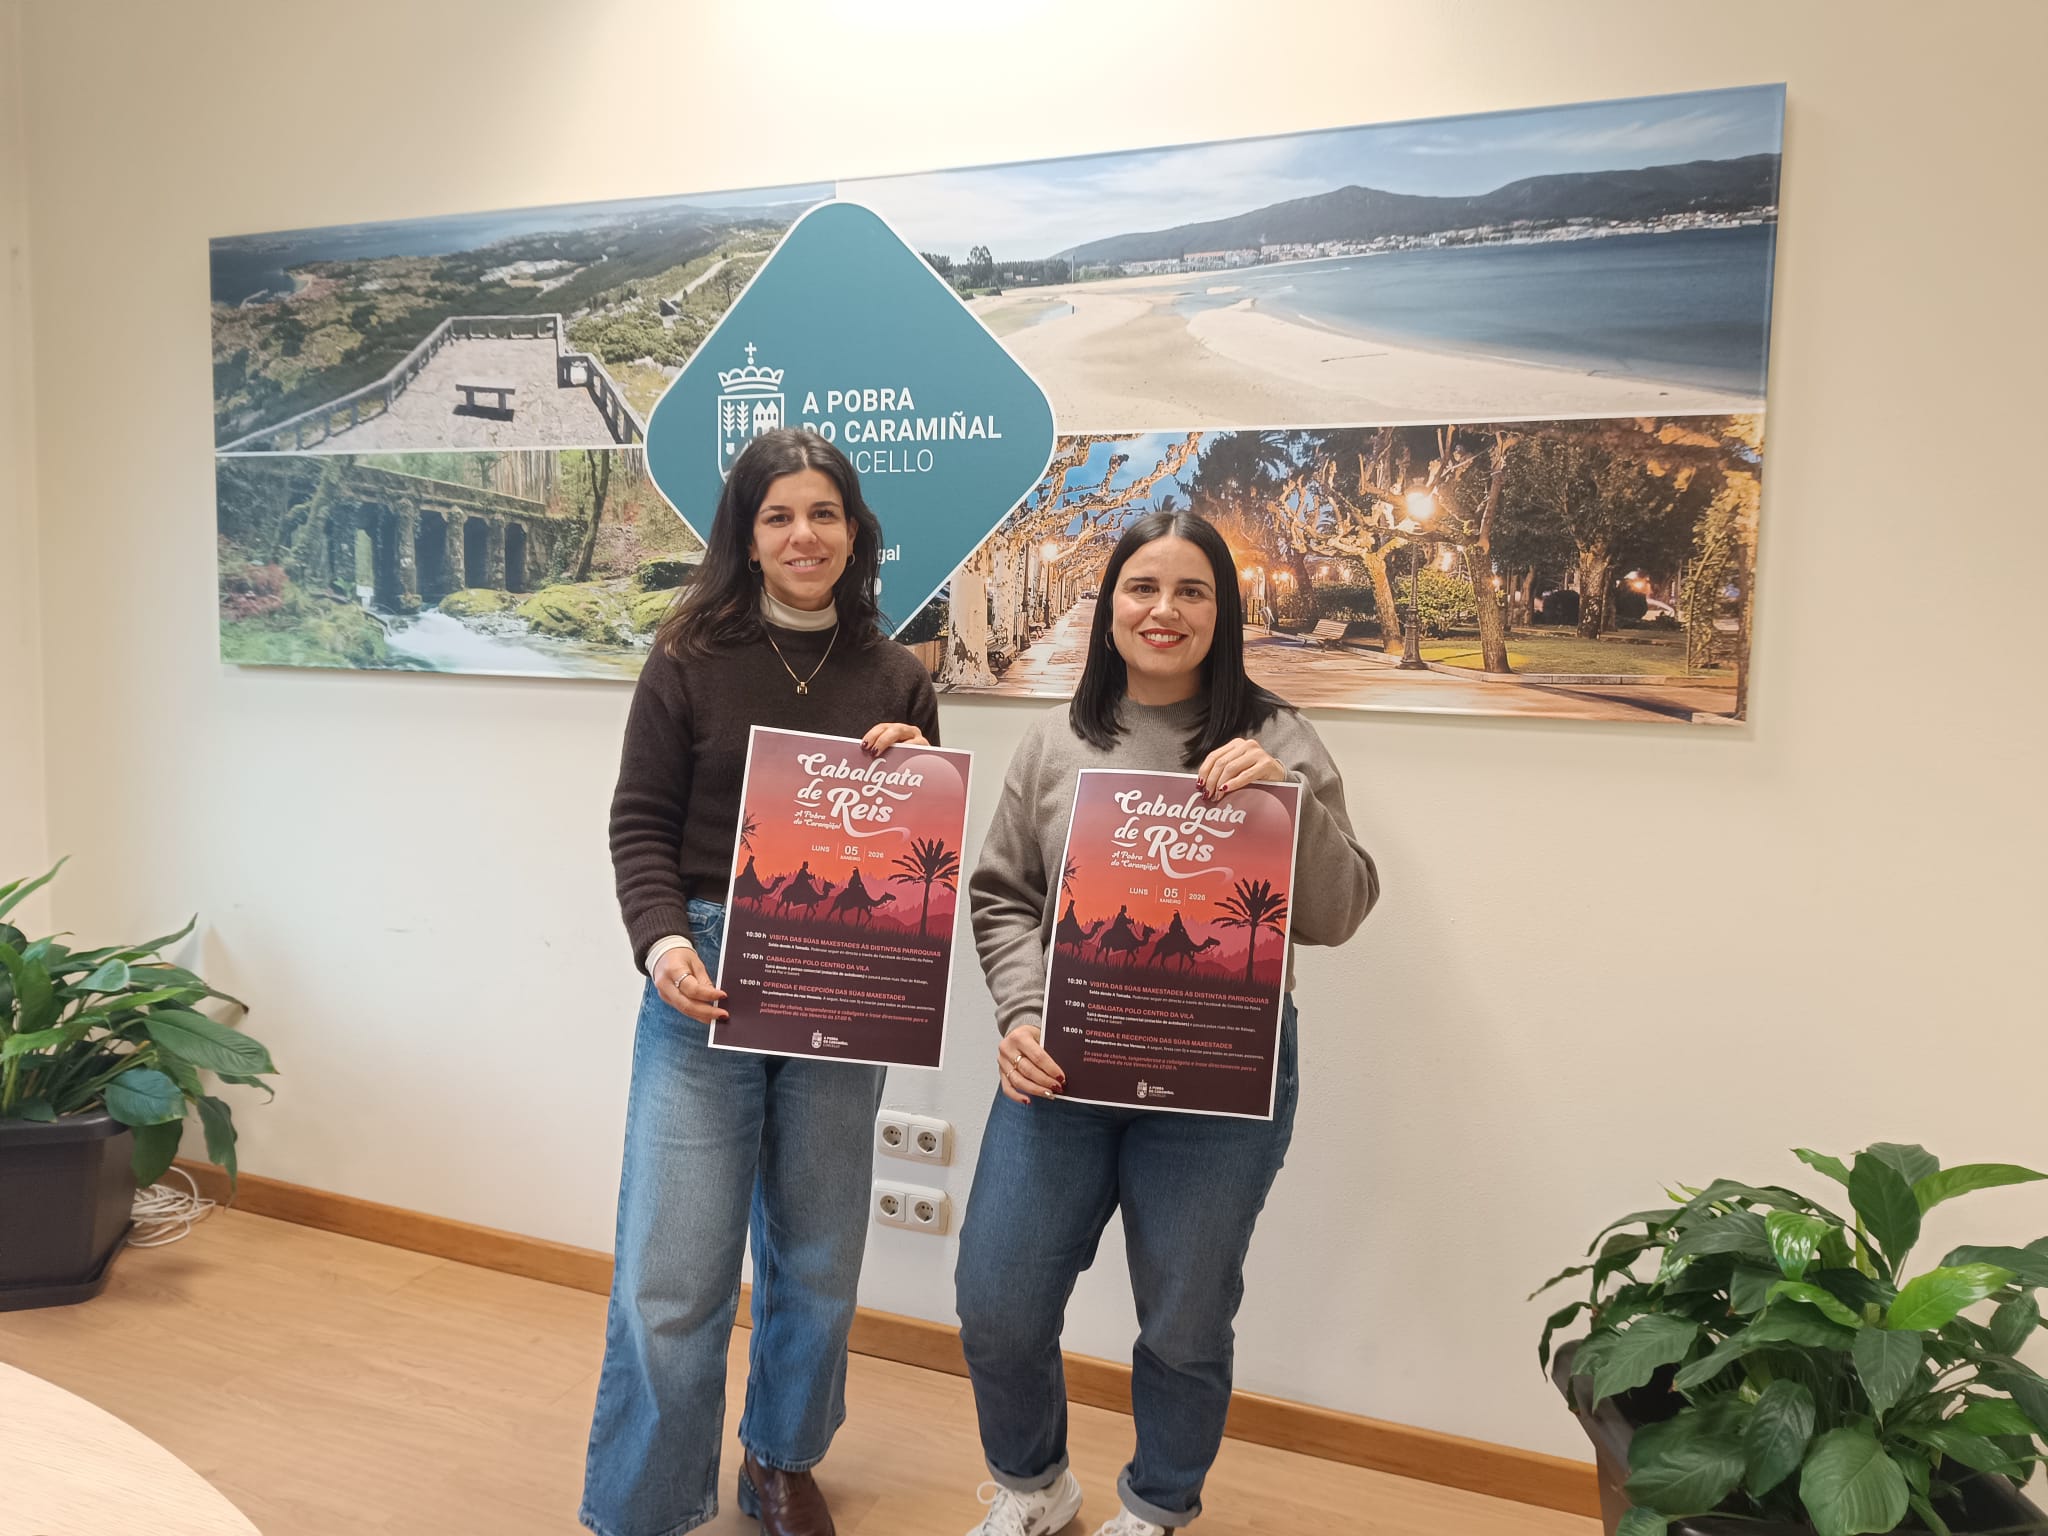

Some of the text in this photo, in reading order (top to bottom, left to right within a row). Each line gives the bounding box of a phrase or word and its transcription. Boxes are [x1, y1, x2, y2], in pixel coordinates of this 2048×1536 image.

[802, 387, 915, 414] A POBRA
[844, 410, 1002, 443] CARAMIÑAL
[850, 449, 934, 474] CELLO
[797, 753, 923, 800] Cabalgata
[797, 778, 899, 837] de Reis
[804, 810, 826, 820] Pobra
[1114, 789, 1247, 839] Cabalgata
[811, 844, 831, 853] LUNS
[844, 845, 858, 856] 05
[1114, 816, 1222, 878] de Reis
[1120, 851, 1143, 861] Pobra
[1129, 887, 1149, 896] LUNS
[1163, 887, 1179, 899] 05
[821, 939, 860, 949] MAXESTADES
[871, 945, 901, 953] DISTINTAS
[902, 948, 940, 958] PARROQUIAS
[767, 956, 802, 964] CABALGATA
[820, 961, 845, 969] CENTRO
[763, 981, 792, 990] OFRENDA
[866, 992, 906, 1002] MAXESTADES
[1142, 986, 1184, 996] MAXESTADES
[1195, 991, 1227, 1000] DISTINTAS
[1228, 994, 1269, 1004] PARROQUIAS
[1087, 1004, 1123, 1013] CABALGATA
[1143, 1009, 1168, 1017] CENTRO
[1086, 1030, 1115, 1039] OFRENDA
[1192, 1040, 1232, 1050] MAXESTADES
